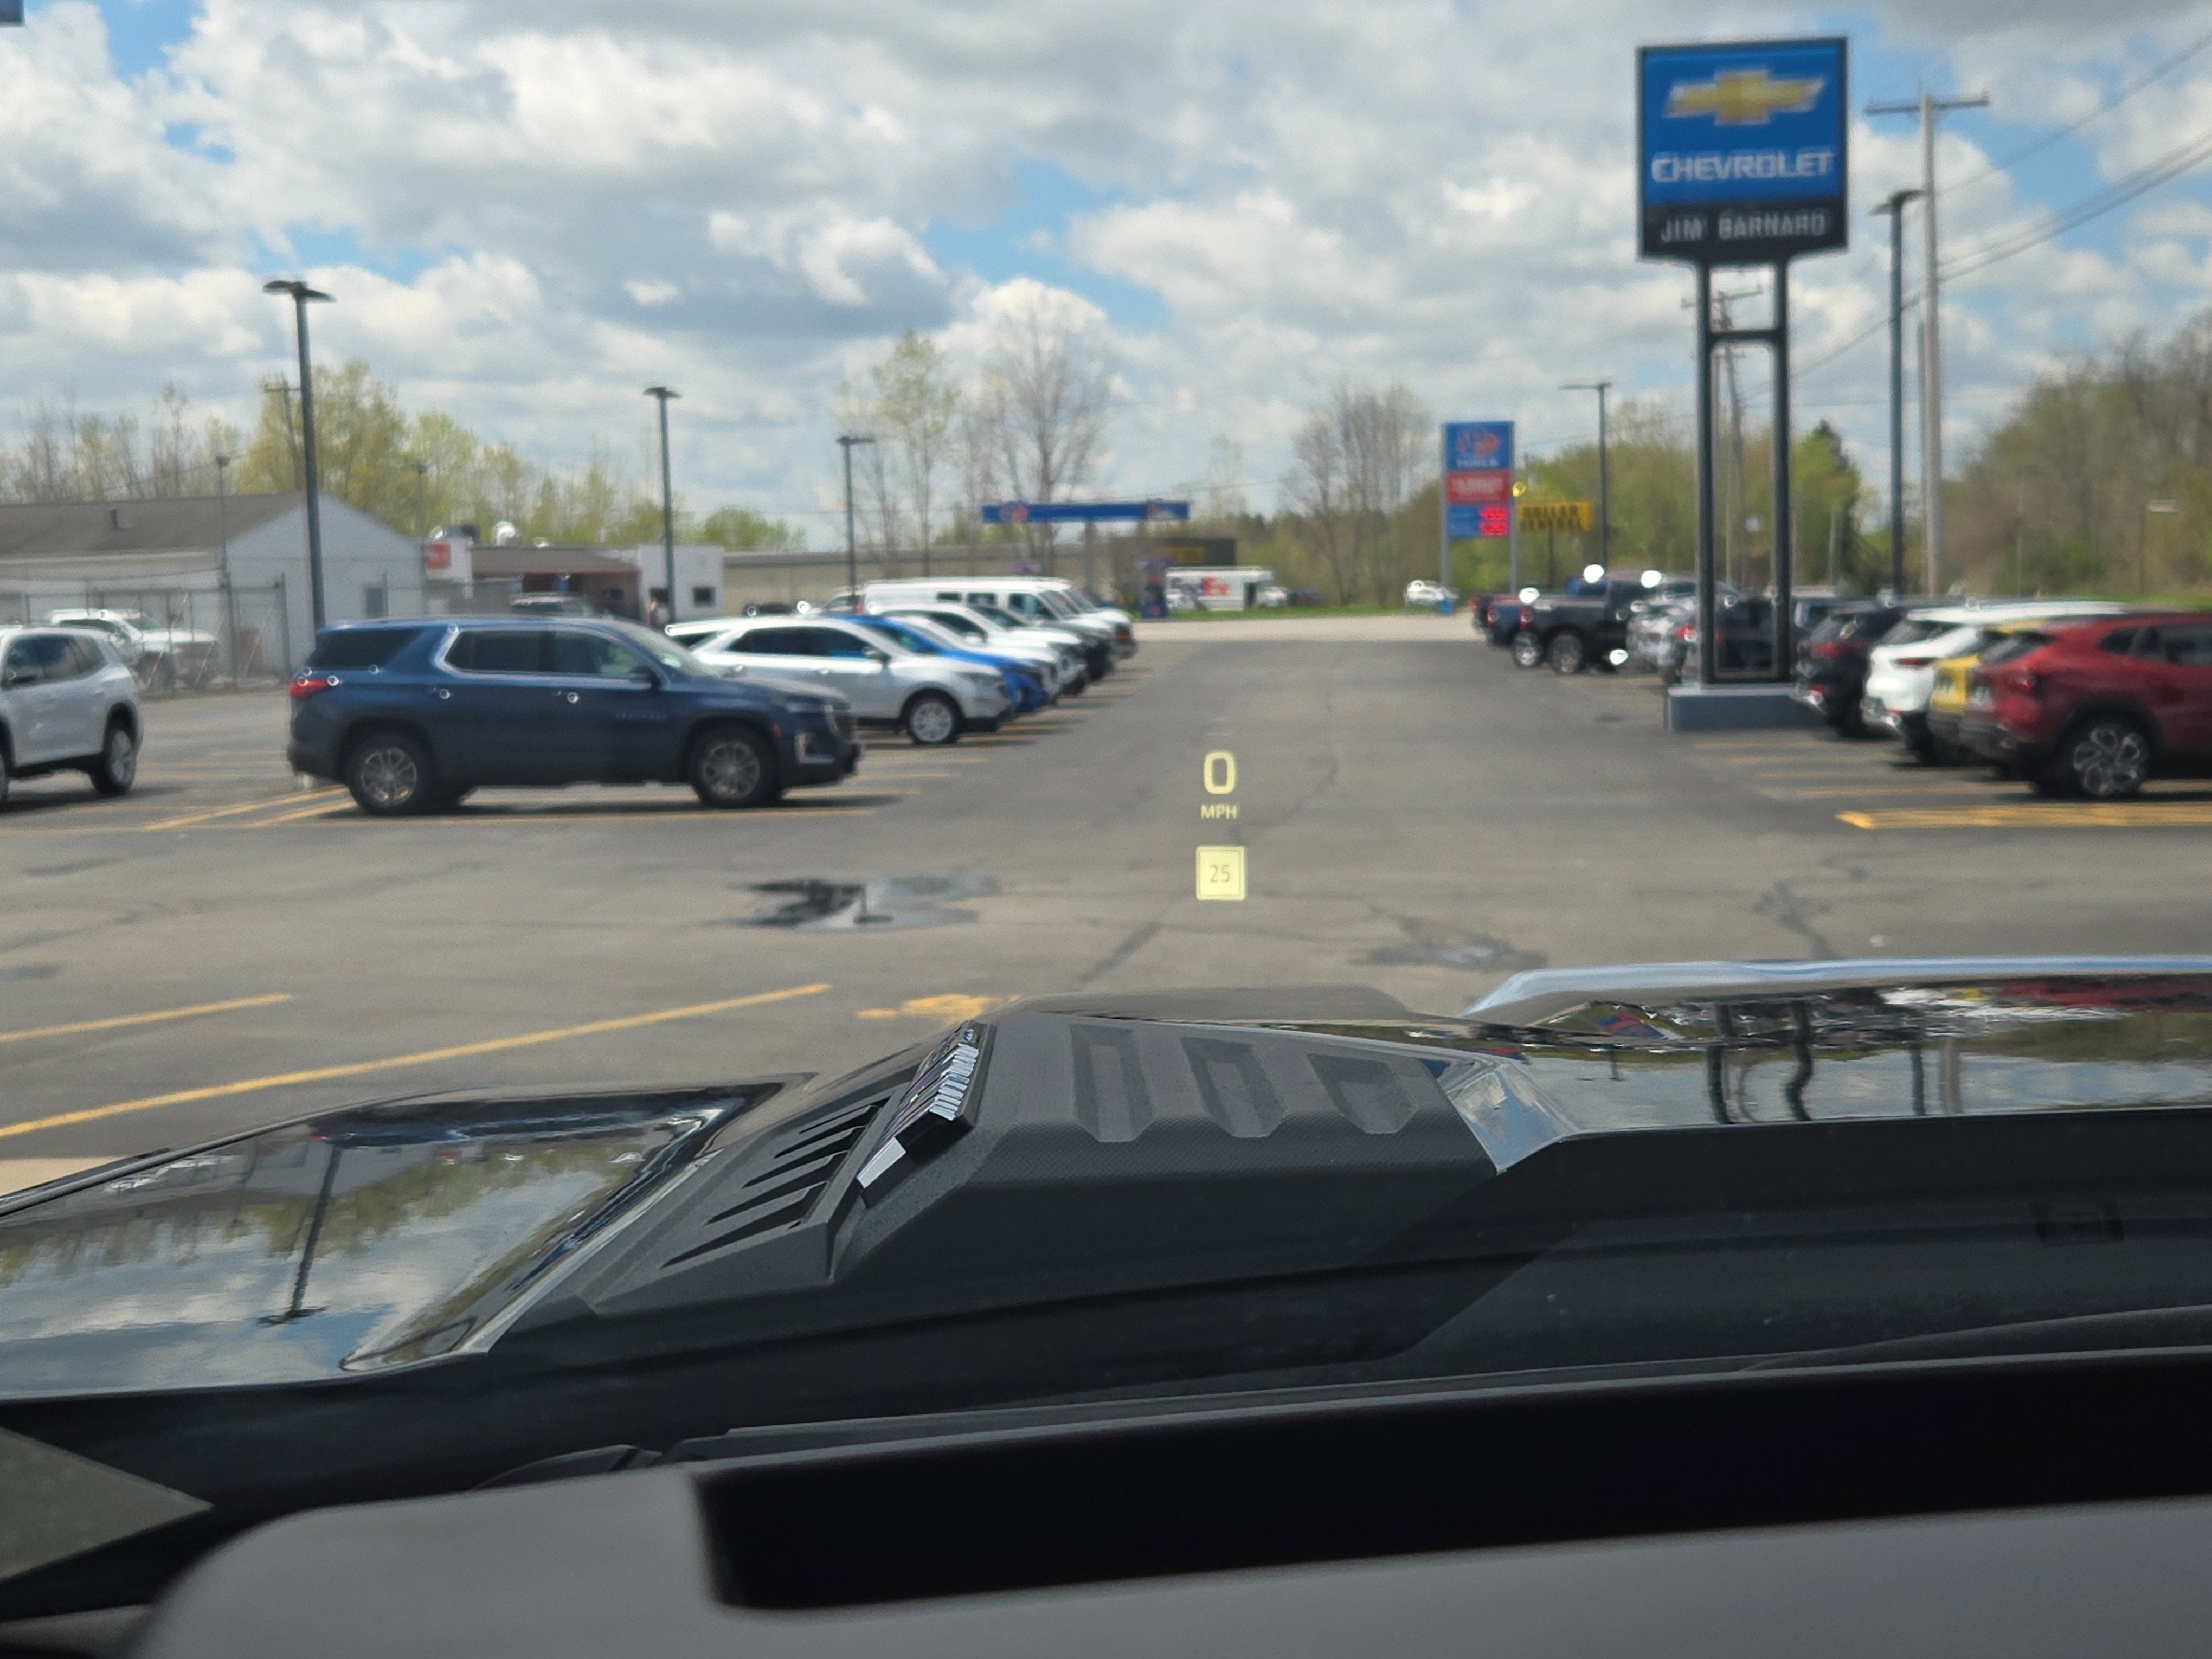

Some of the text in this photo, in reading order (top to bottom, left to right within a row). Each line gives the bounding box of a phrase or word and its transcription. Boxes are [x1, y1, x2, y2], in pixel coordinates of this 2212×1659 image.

[1651, 151, 1834, 183] CHEVROLET
[1661, 212, 1828, 242] JIM BARNARD
[1200, 803, 1238, 819] MPH
[1210, 864, 1231, 884] 25
